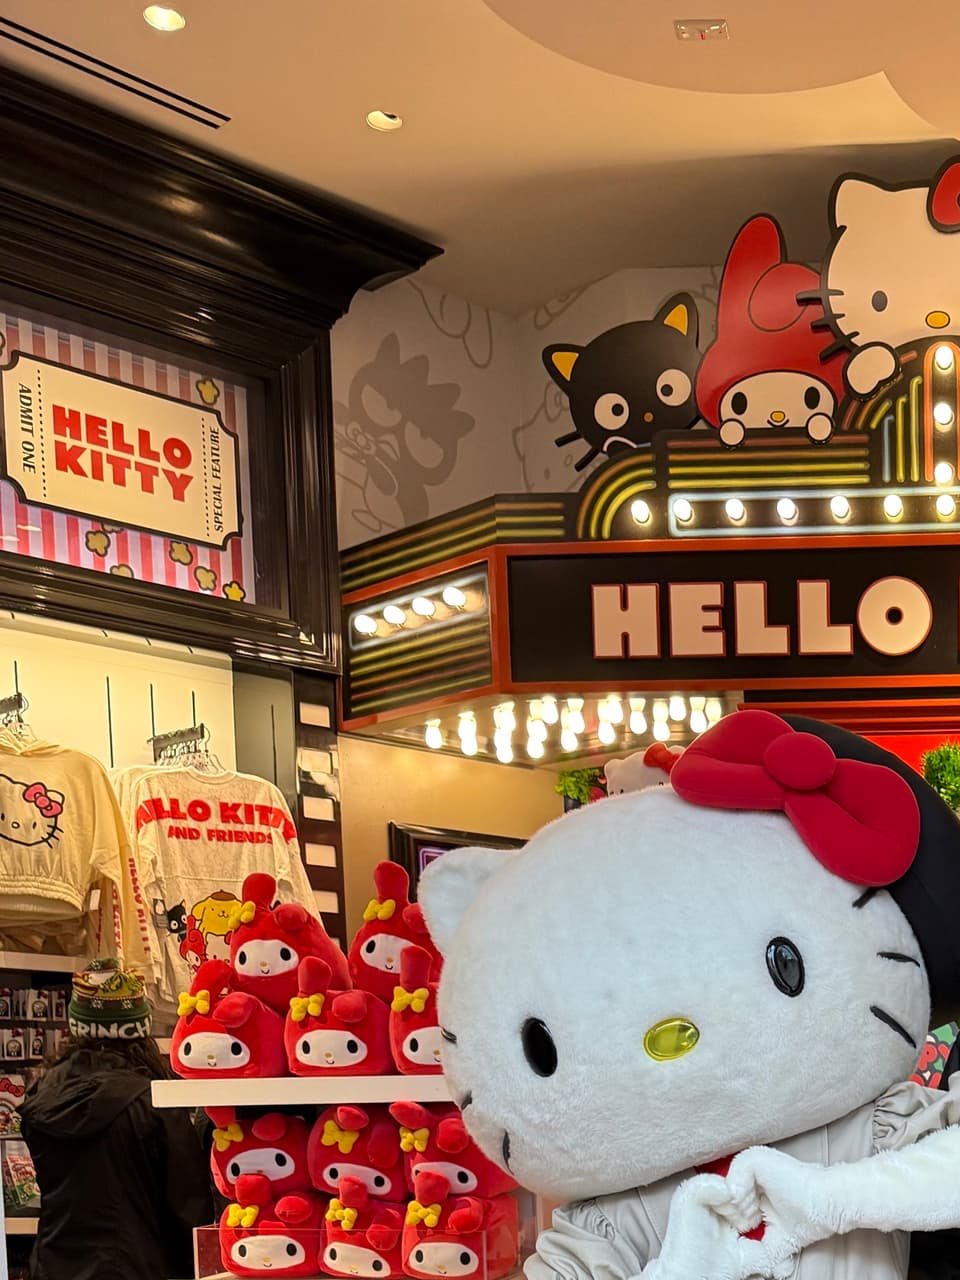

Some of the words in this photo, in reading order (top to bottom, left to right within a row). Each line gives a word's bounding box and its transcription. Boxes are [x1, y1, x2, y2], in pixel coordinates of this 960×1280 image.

[18, 383, 34, 437] ADMIT
[52, 404, 192, 470] HELLO
[22, 441, 36, 474] ONE
[54, 439, 194, 503] KITTY
[209, 426, 221, 480] FEATURE
[212, 482, 224, 532] SPECIAL
[592, 575, 933, 659] HELLO
